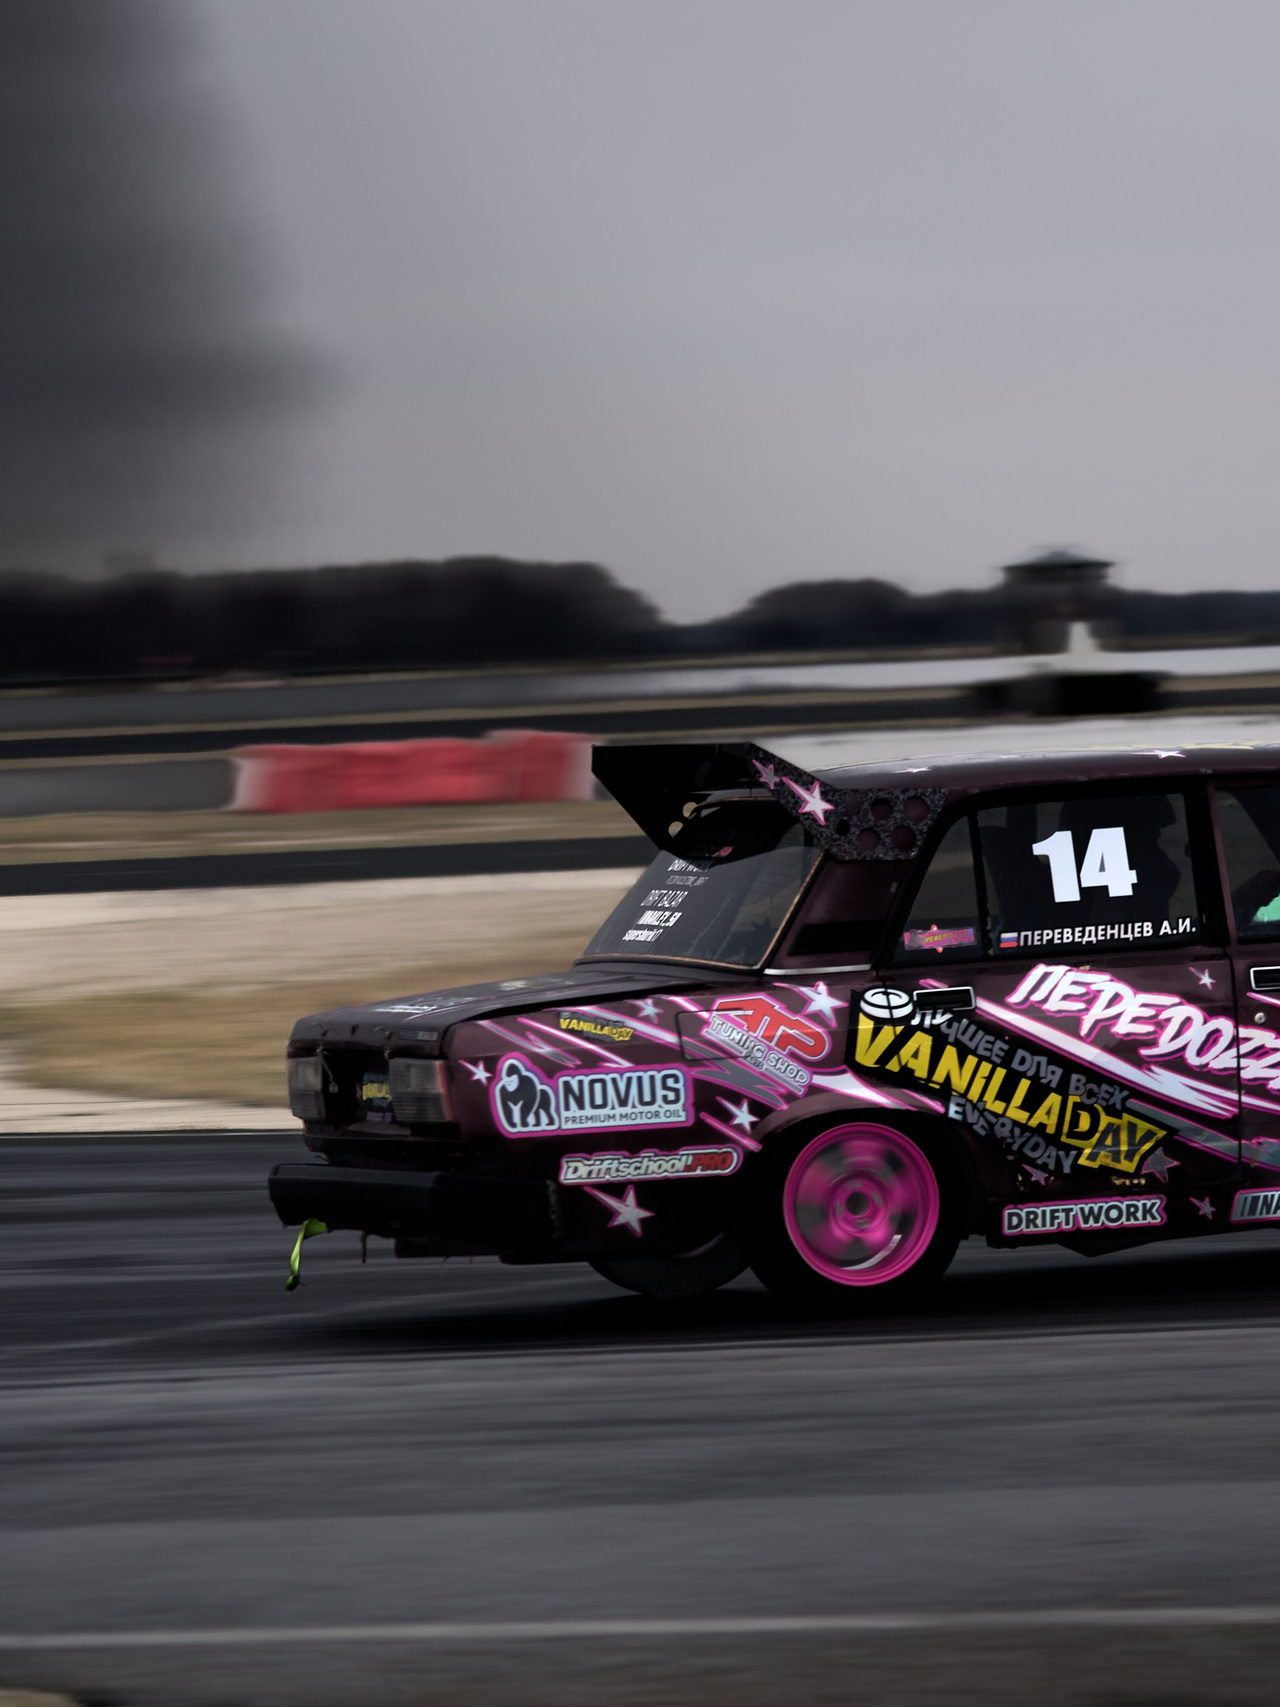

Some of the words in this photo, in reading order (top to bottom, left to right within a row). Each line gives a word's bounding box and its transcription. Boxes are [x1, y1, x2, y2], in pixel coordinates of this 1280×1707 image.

[1032, 826, 1138, 903] 14
[1019, 921, 1153, 947] ПЕРЕВЕДЕНЦЕВ
[1159, 917, 1197, 935] А.И.
[711, 1017, 767, 1058] TUNING
[766, 1051, 809, 1085] SHOP
[910, 1007, 1011, 1064] ЛУЧШЕЕ
[1068, 1073, 1130, 1111] ВСЕХ
[562, 1073, 681, 1112] NOVUS
[564, 1113, 616, 1125] PREMIUM
[619, 1110, 661, 1122] MOTOR
[663, 1109, 682, 1119] OIL
[948, 1096, 1078, 1175] EVERYDAY
[1006, 1206, 1076, 1232] DRIFT
[1077, 1200, 1161, 1227] WORK
